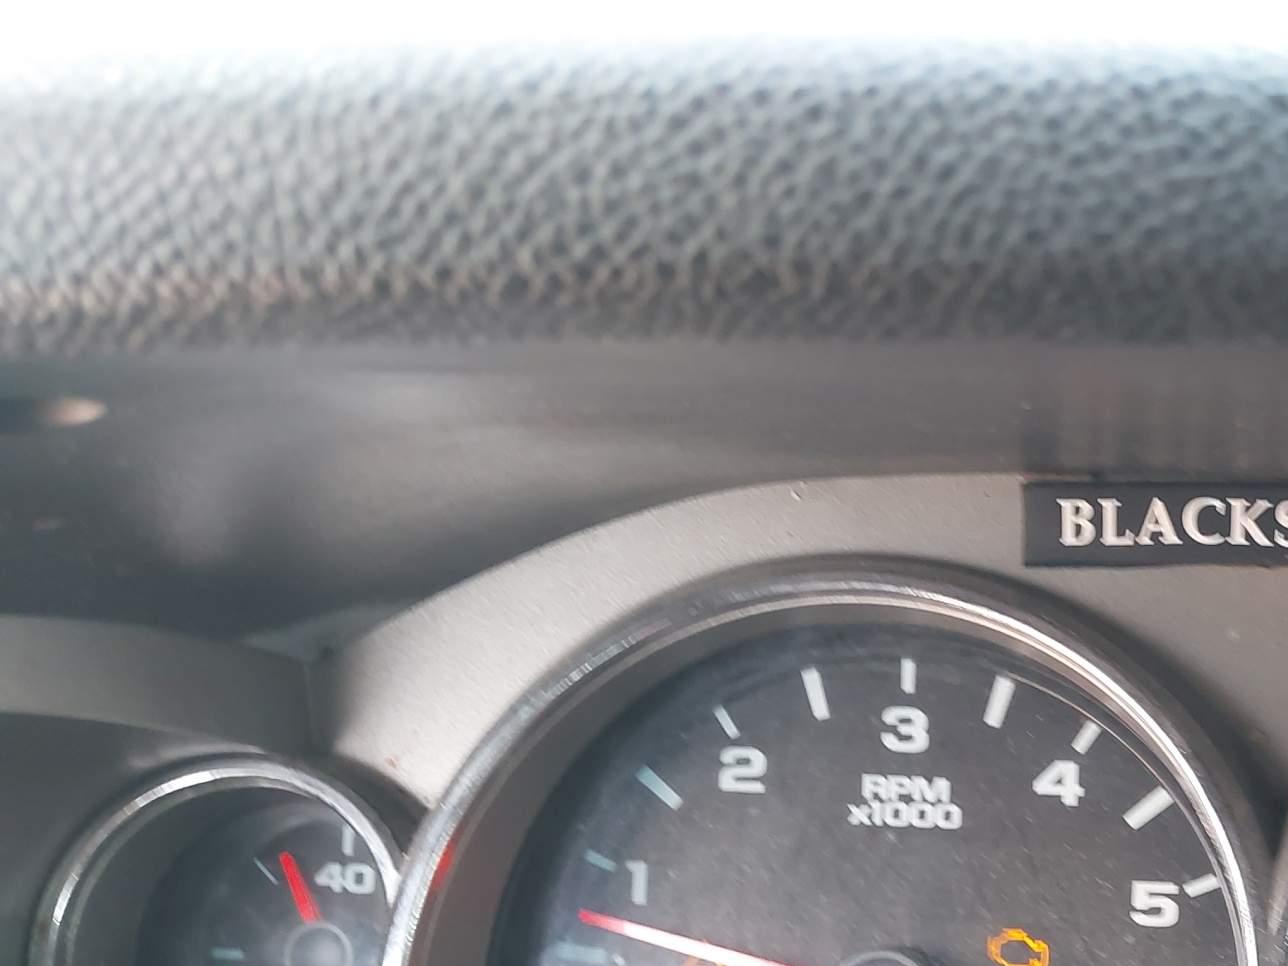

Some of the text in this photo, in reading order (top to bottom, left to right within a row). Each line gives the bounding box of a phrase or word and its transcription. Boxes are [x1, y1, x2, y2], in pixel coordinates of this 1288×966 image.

[880, 706, 930, 753] 3
[718, 746, 767, 793] 2
[861, 773, 951, 802] RPM
[1032, 760, 1085, 807] 4
[847, 800, 963, 829] x1000
[314, 862, 377, 894] 40
[625, 860, 648, 905] 1
[1129, 880, 1179, 927] 5
